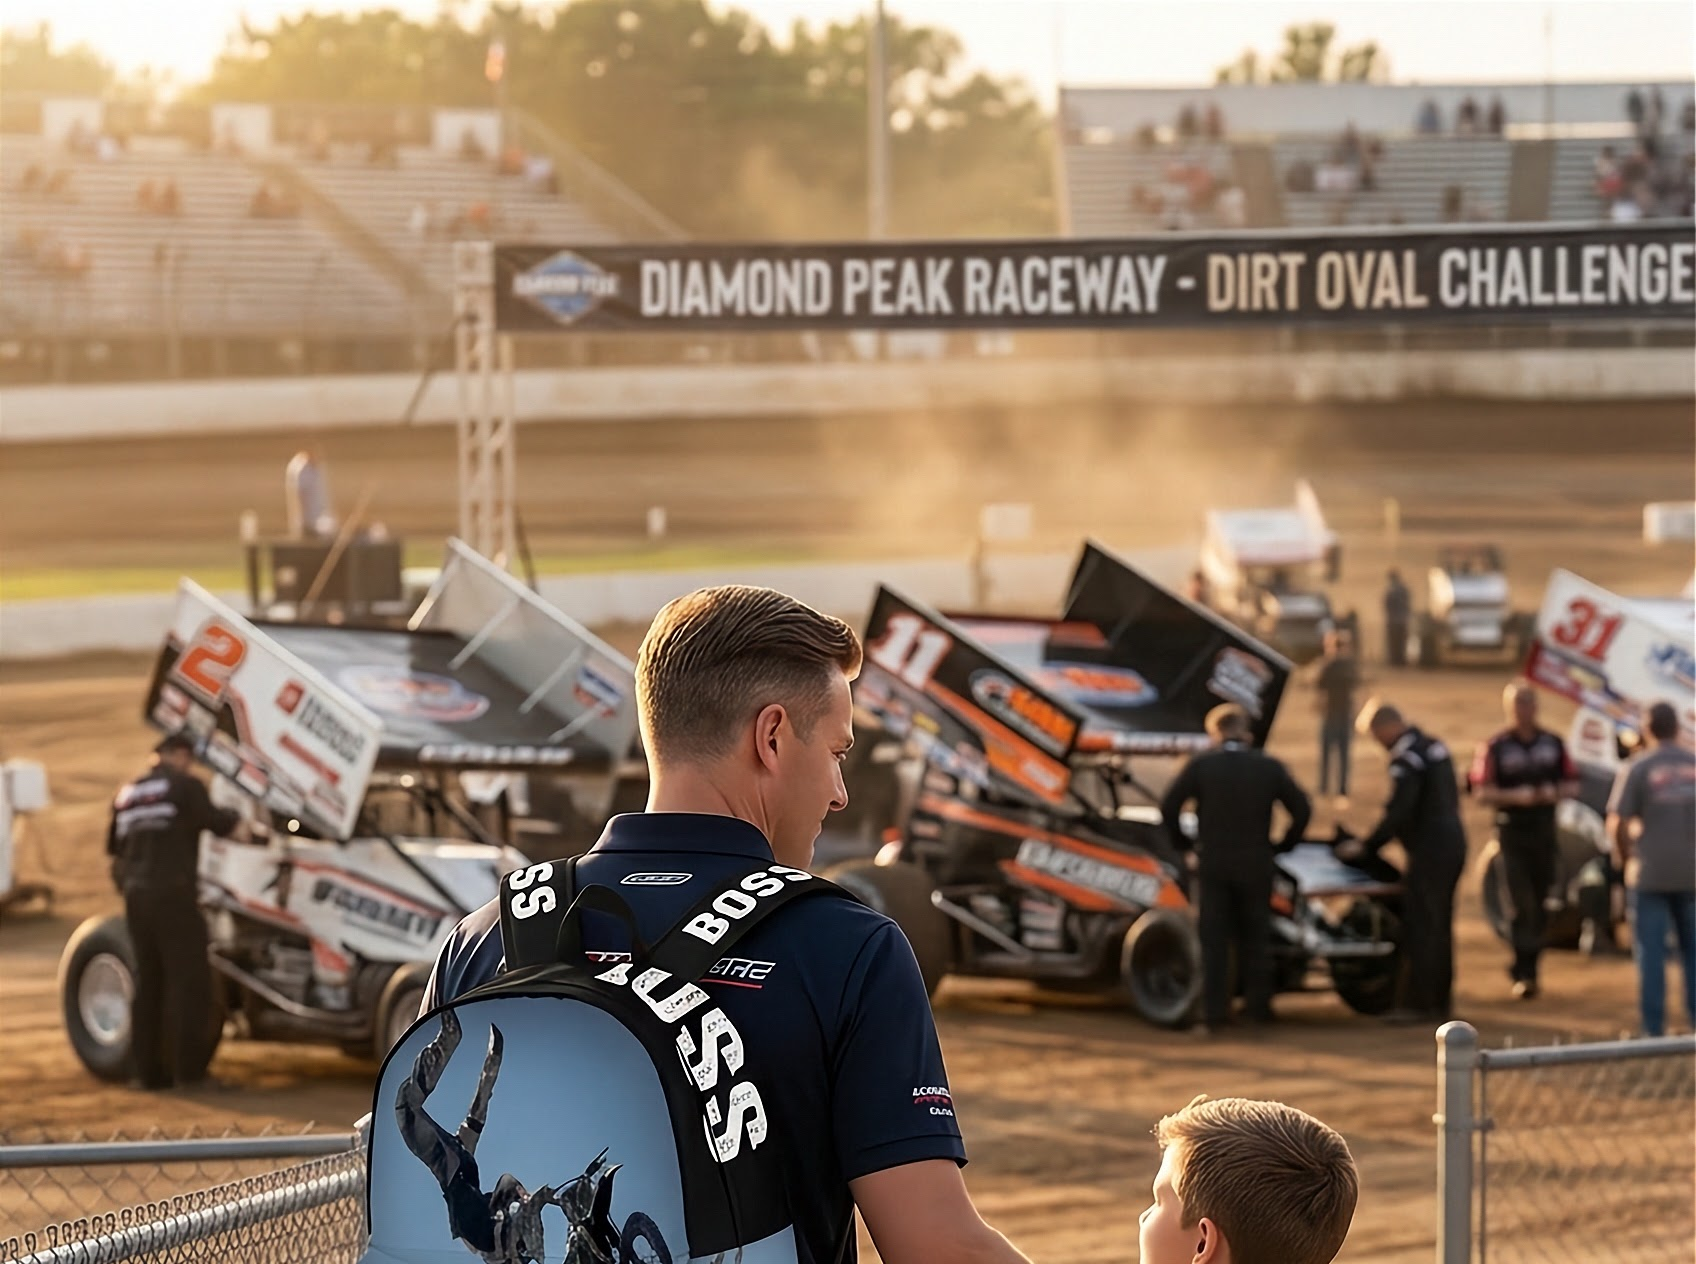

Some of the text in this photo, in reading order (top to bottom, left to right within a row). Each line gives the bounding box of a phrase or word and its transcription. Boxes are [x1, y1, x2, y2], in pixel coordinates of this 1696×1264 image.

[641, 258, 832, 317] DIAMOND
[843, 257, 953, 316] PEAK
[964, 254, 1167, 315] RACEWAY
[1176, 275, 1196, 291] -
[1207, 252, 1306, 311] DIRT
[1316, 249, 1428, 310] OVAL
[1439, 242, 1695, 307] CHALLENGE
[178, 624, 246, 699] 2
[866, 611, 952, 690] 11
[1553, 597, 1625, 661] 31
